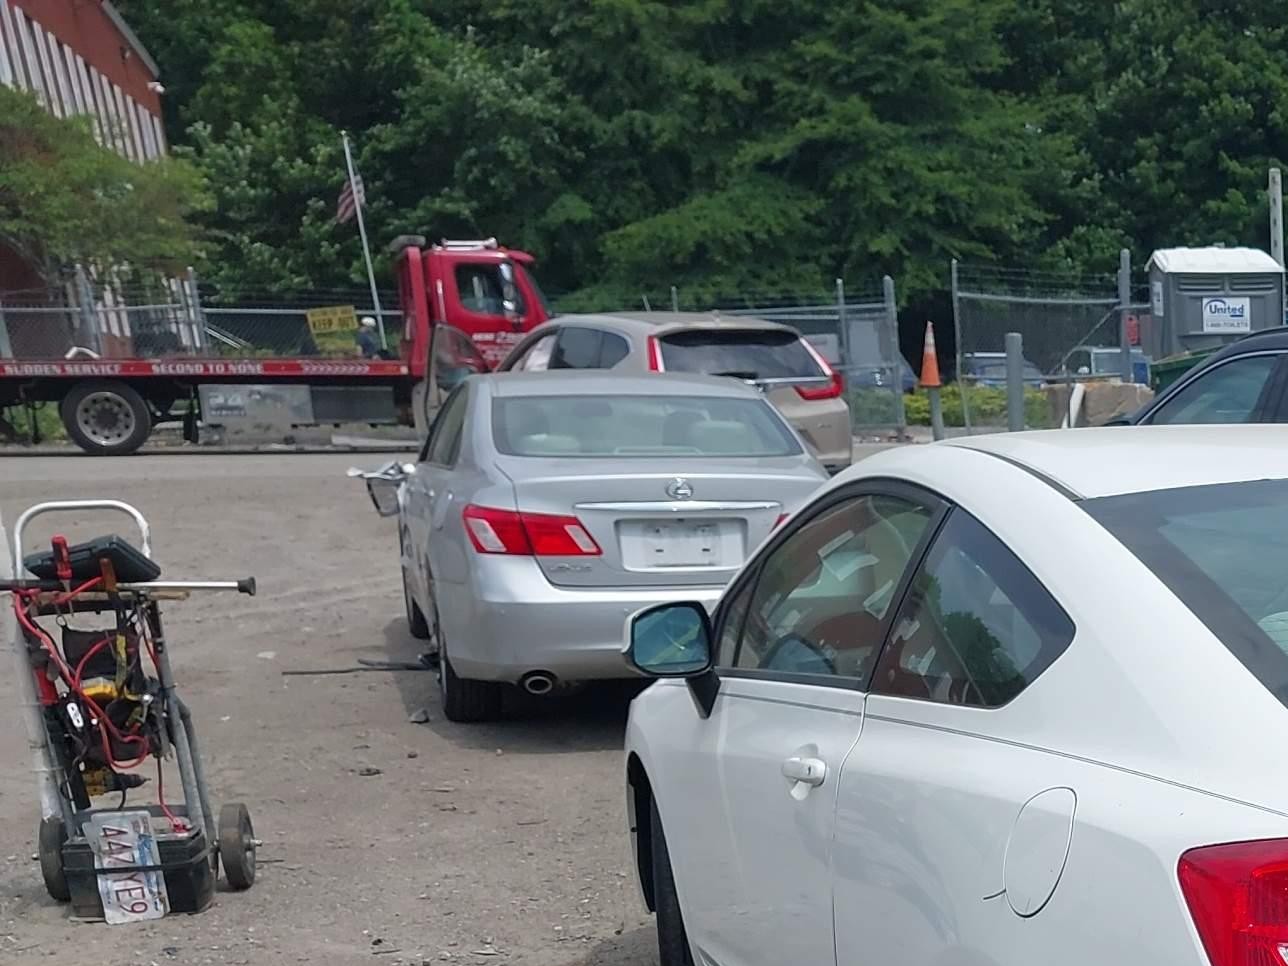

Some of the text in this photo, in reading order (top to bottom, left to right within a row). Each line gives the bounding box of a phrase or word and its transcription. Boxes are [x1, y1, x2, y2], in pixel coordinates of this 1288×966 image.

[1209, 303, 1245, 315] United
[64, 364, 121, 376] SERVICE
[152, 363, 264, 375] SECOND TO NONE
